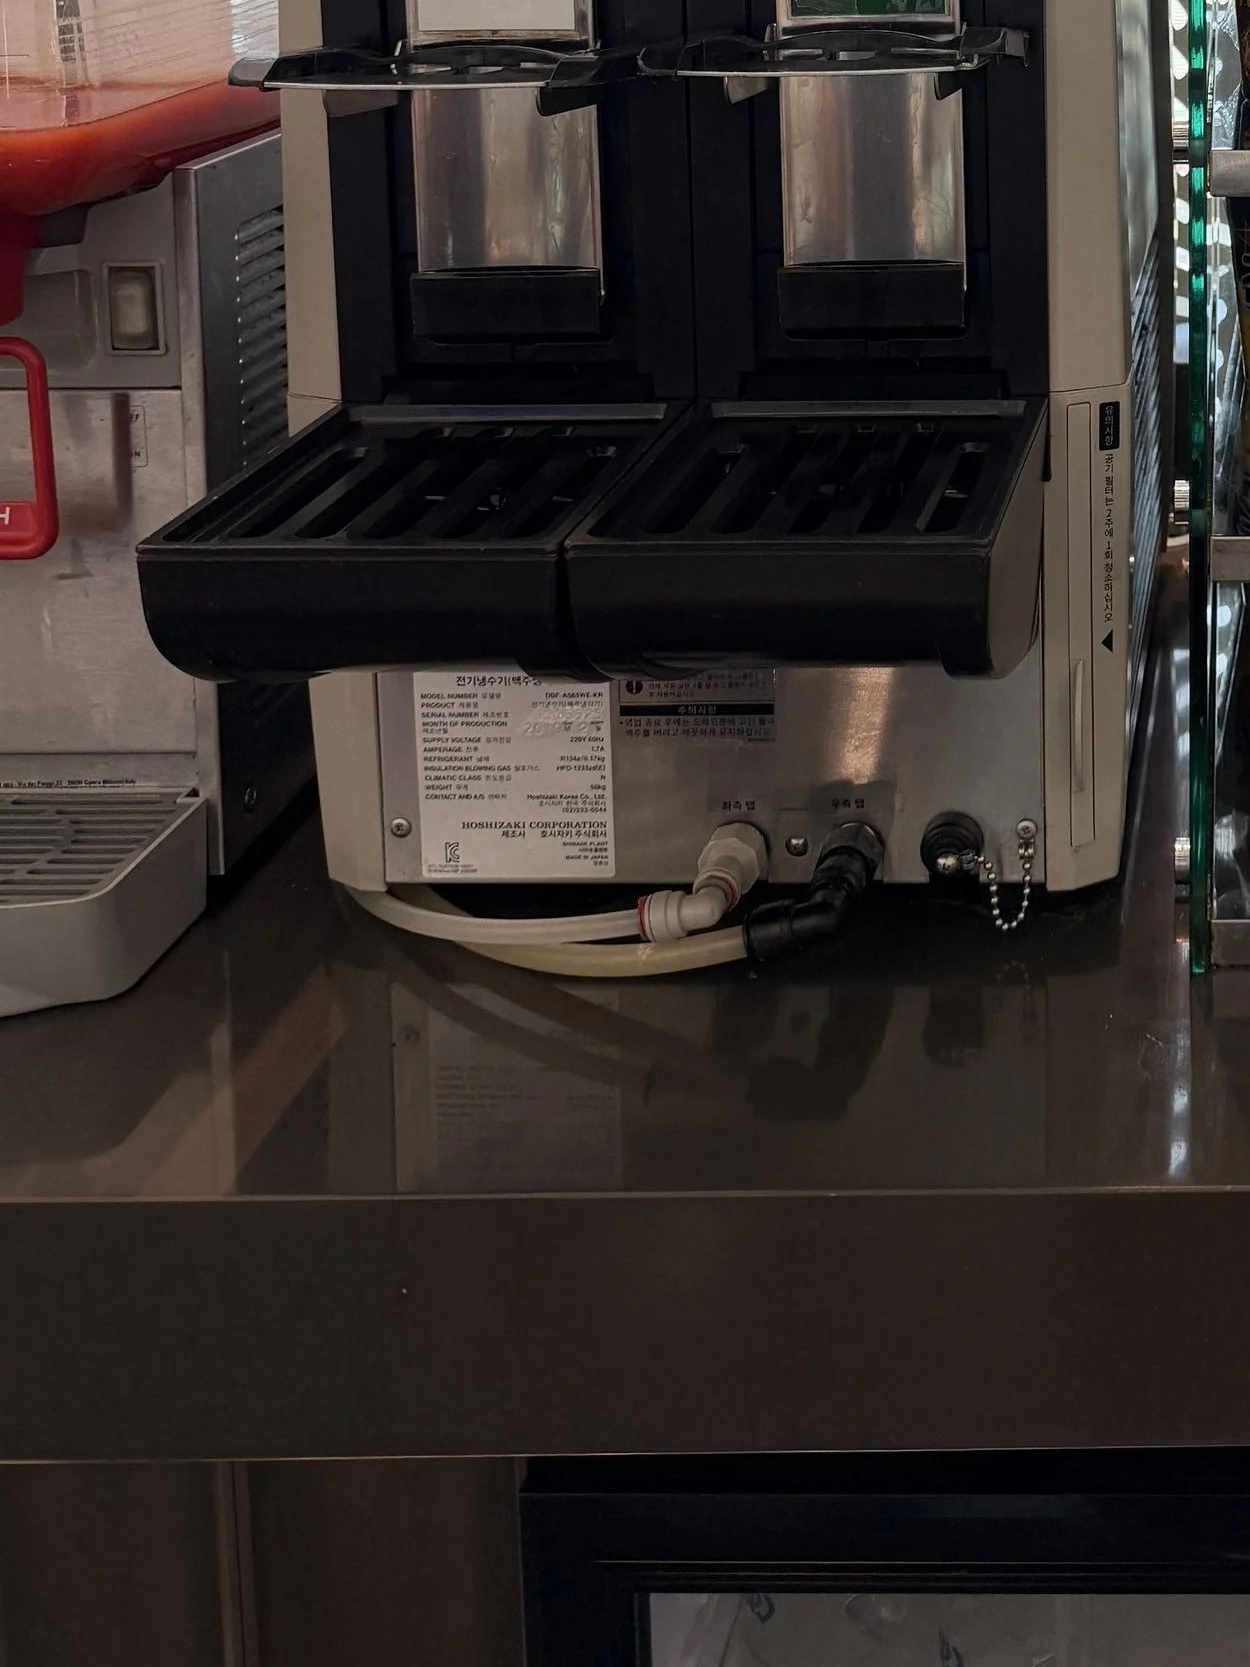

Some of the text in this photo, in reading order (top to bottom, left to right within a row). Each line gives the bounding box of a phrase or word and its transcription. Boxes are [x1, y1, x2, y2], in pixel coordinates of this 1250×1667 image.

[1104, 453, 1114, 622] 공기 필터는 2주에 1회 청소하십시오
[462, 821, 608, 829] HOSHIZAKI CORPORATION
